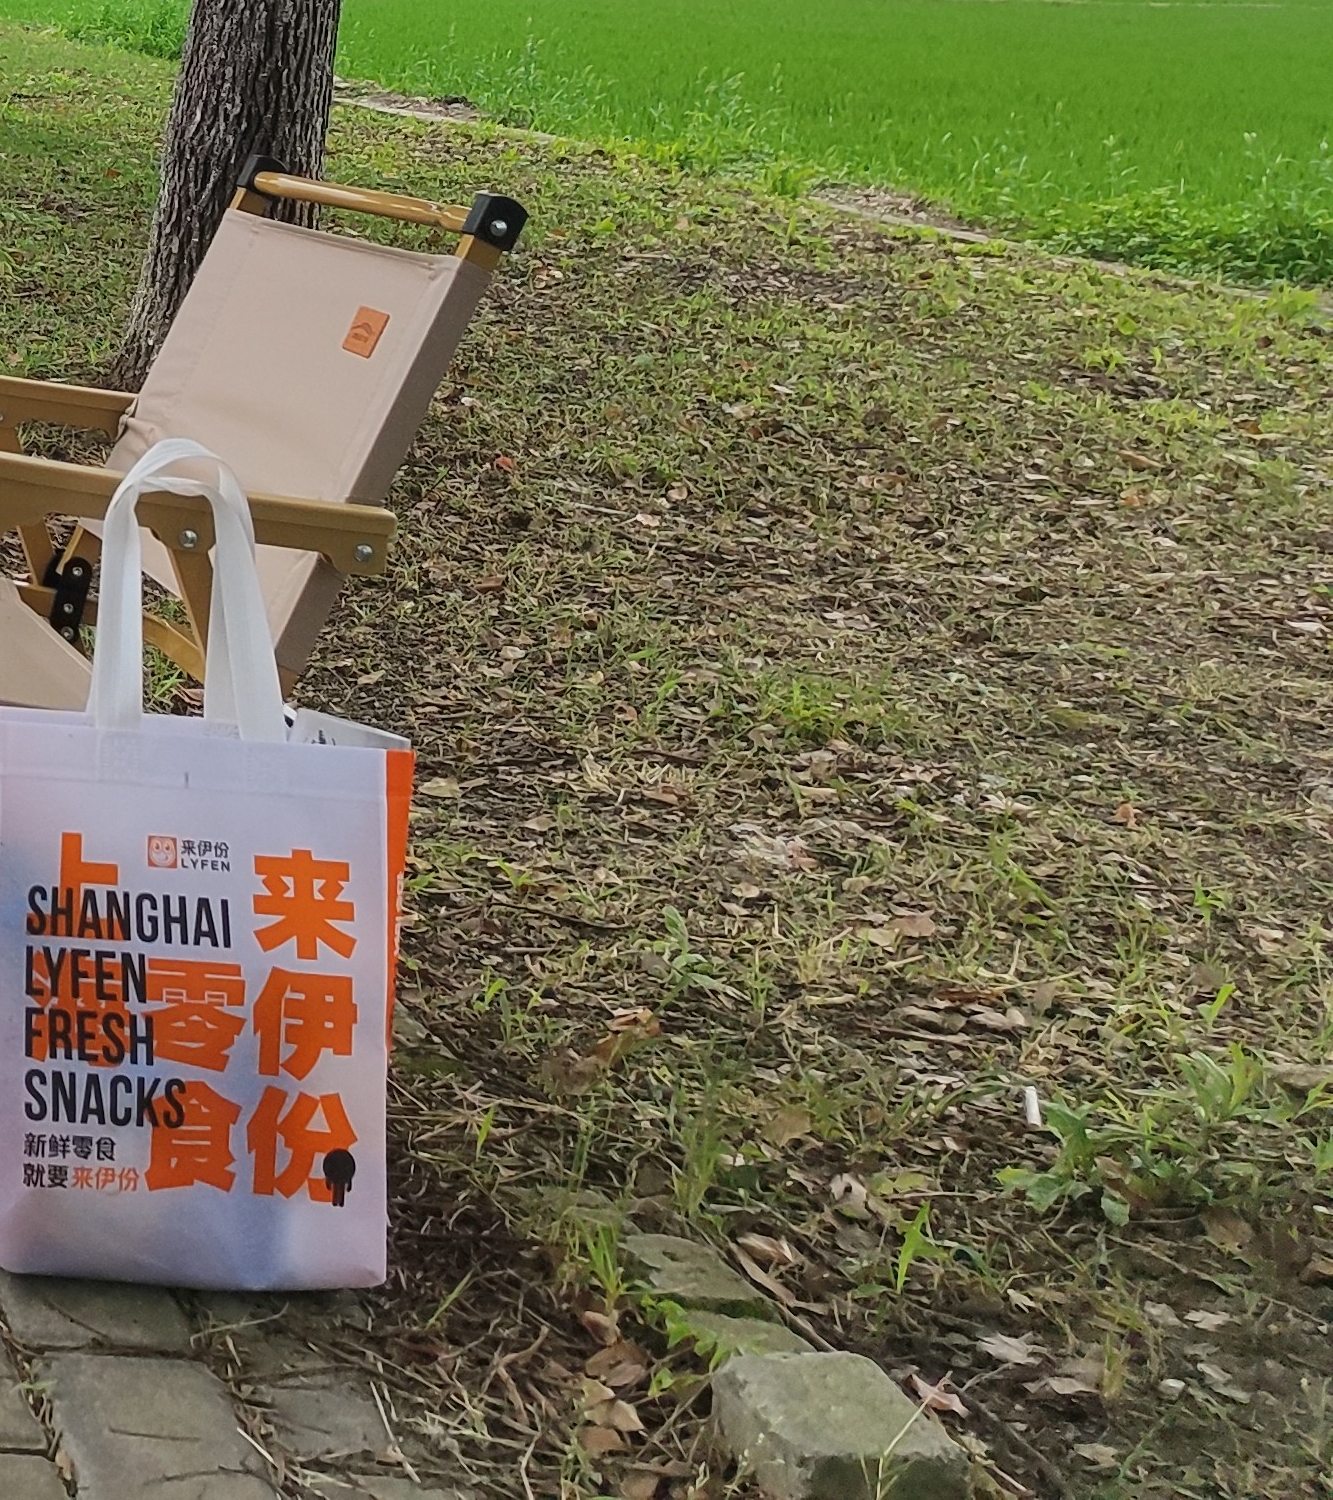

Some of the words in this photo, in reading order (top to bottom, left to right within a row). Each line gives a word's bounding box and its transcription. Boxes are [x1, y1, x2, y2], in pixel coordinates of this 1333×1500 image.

[181, 839, 229, 858] 来伊份
[181, 858, 231, 872] LYFEN
[26, 885, 232, 948] SHANGHAI
[25, 945, 148, 1004] LYFEN
[25, 1006, 154, 1066] FRESH
[247, 849, 359, 1202] 来伊份
[24, 1068, 186, 1129] SNACKS
[23, 1132, 116, 1161] 新鲜零食
